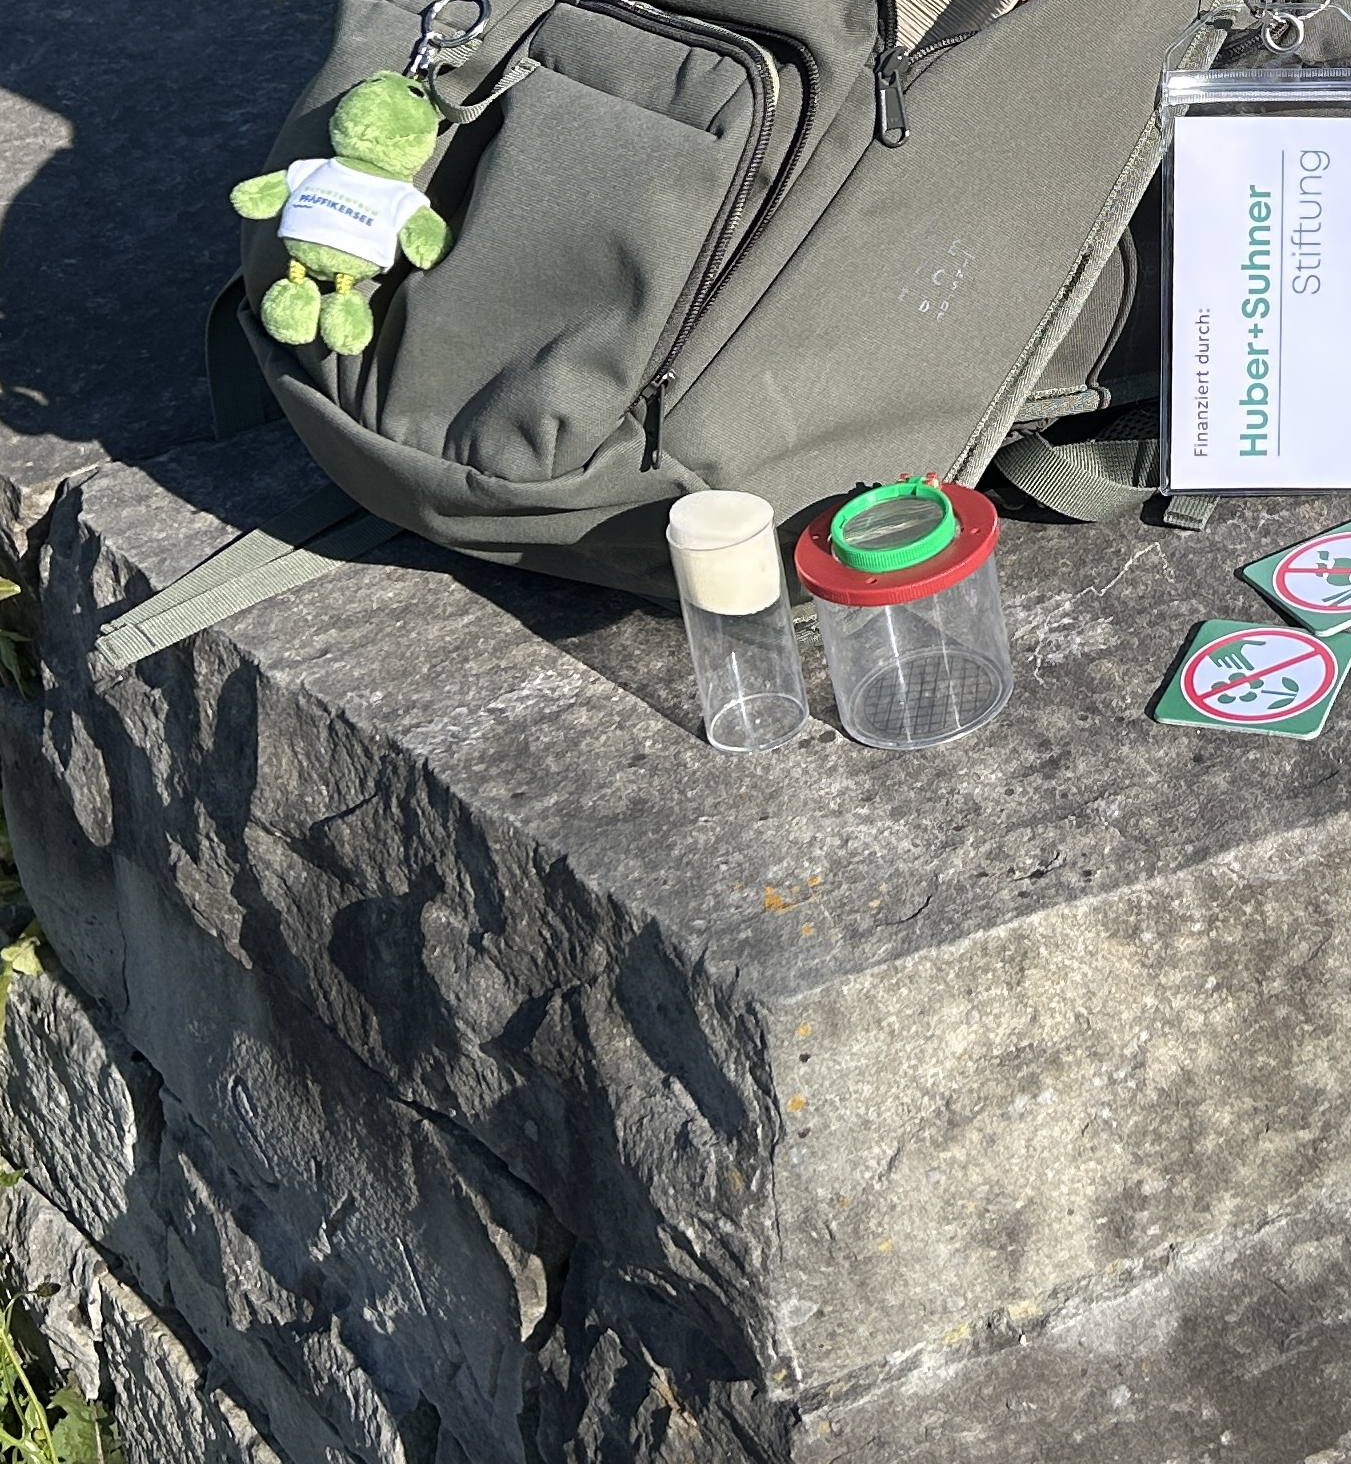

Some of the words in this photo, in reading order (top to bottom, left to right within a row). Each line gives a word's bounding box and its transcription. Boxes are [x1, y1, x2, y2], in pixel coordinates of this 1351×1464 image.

[298, 192, 375, 227] PFÄFFIKERSEE
[1291, 148, 1331, 296] Stiftung
[1194, 307, 1212, 364] durch:
[1239, 184, 1273, 458] Huber+Suhner
[1193, 369, 1211, 458] Finanziert
